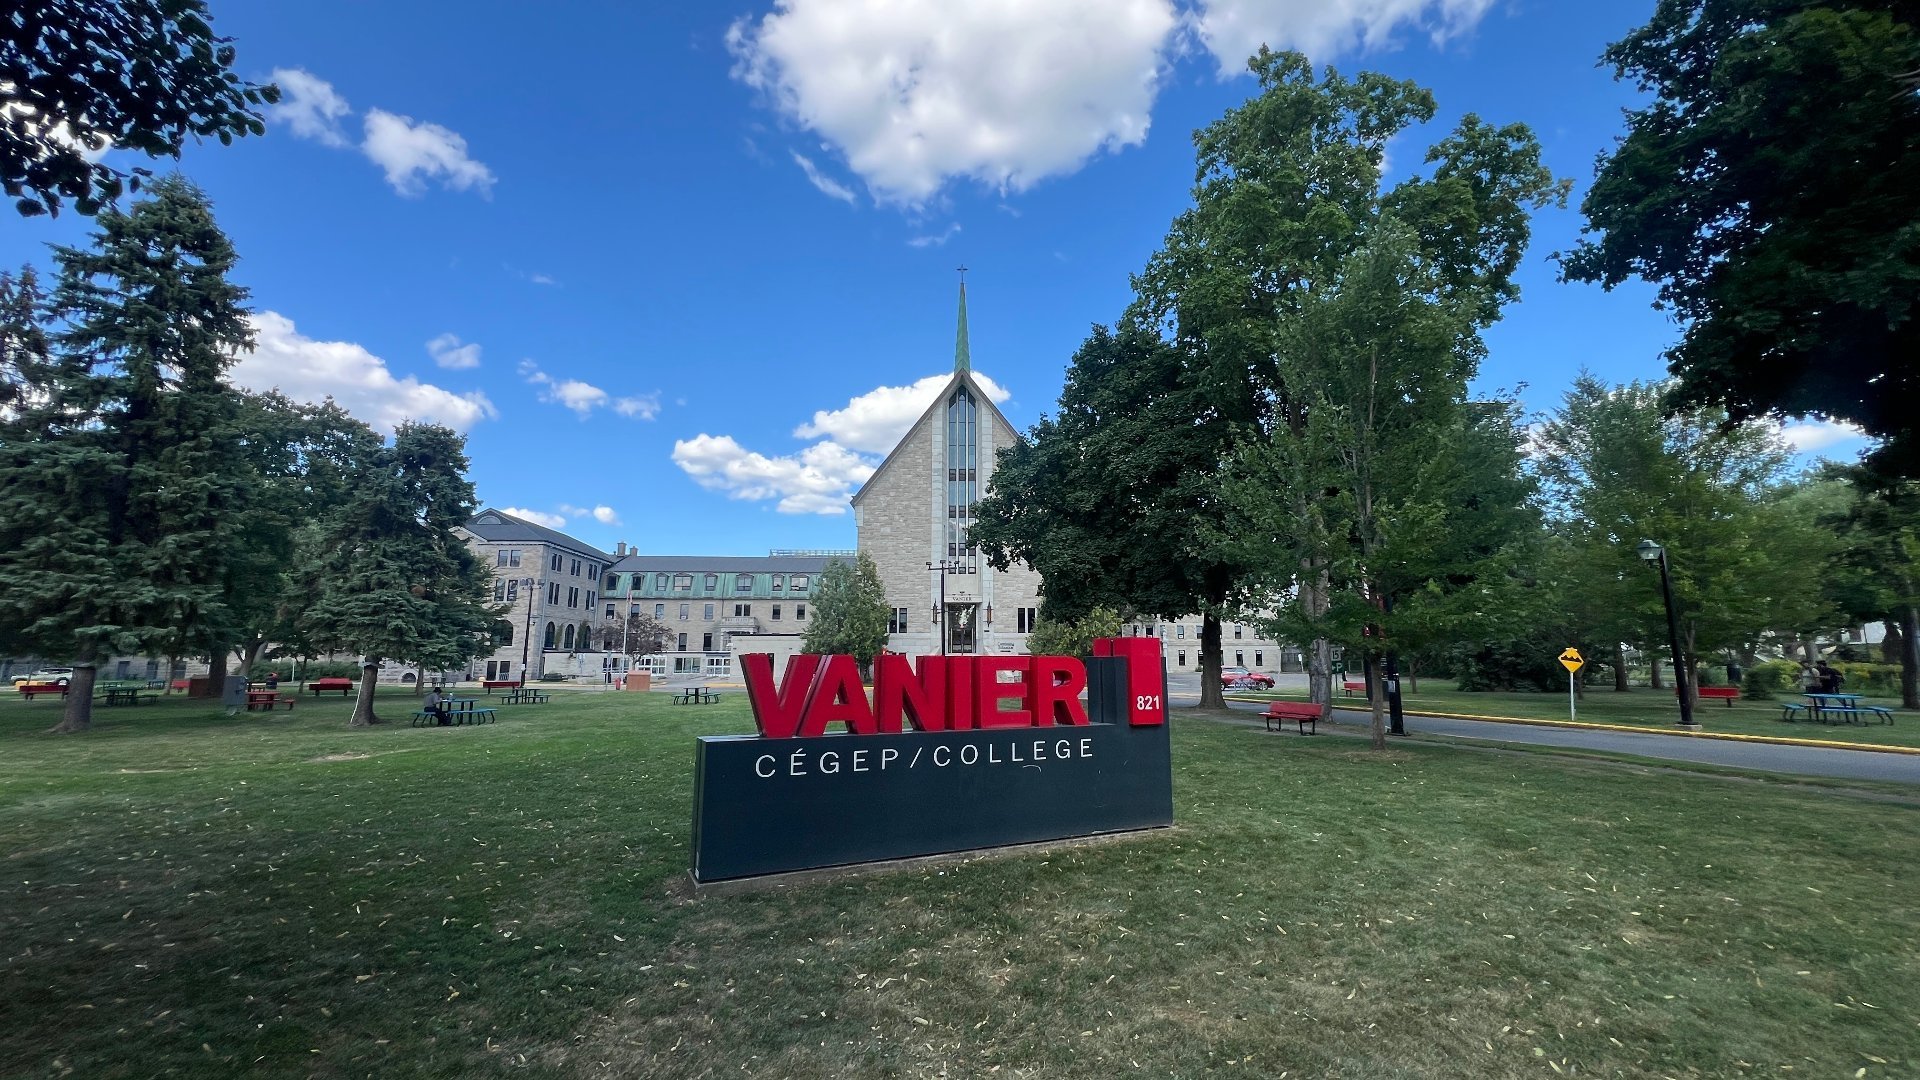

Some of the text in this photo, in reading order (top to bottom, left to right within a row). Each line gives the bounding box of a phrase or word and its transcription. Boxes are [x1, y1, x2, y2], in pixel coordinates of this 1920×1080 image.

[1332, 650, 1340, 660] 15
[739, 653, 1089, 739] VANIER
[1137, 695, 1160, 710] 821
[755, 738, 1093, 778] CÉGEP/COLLEGE
